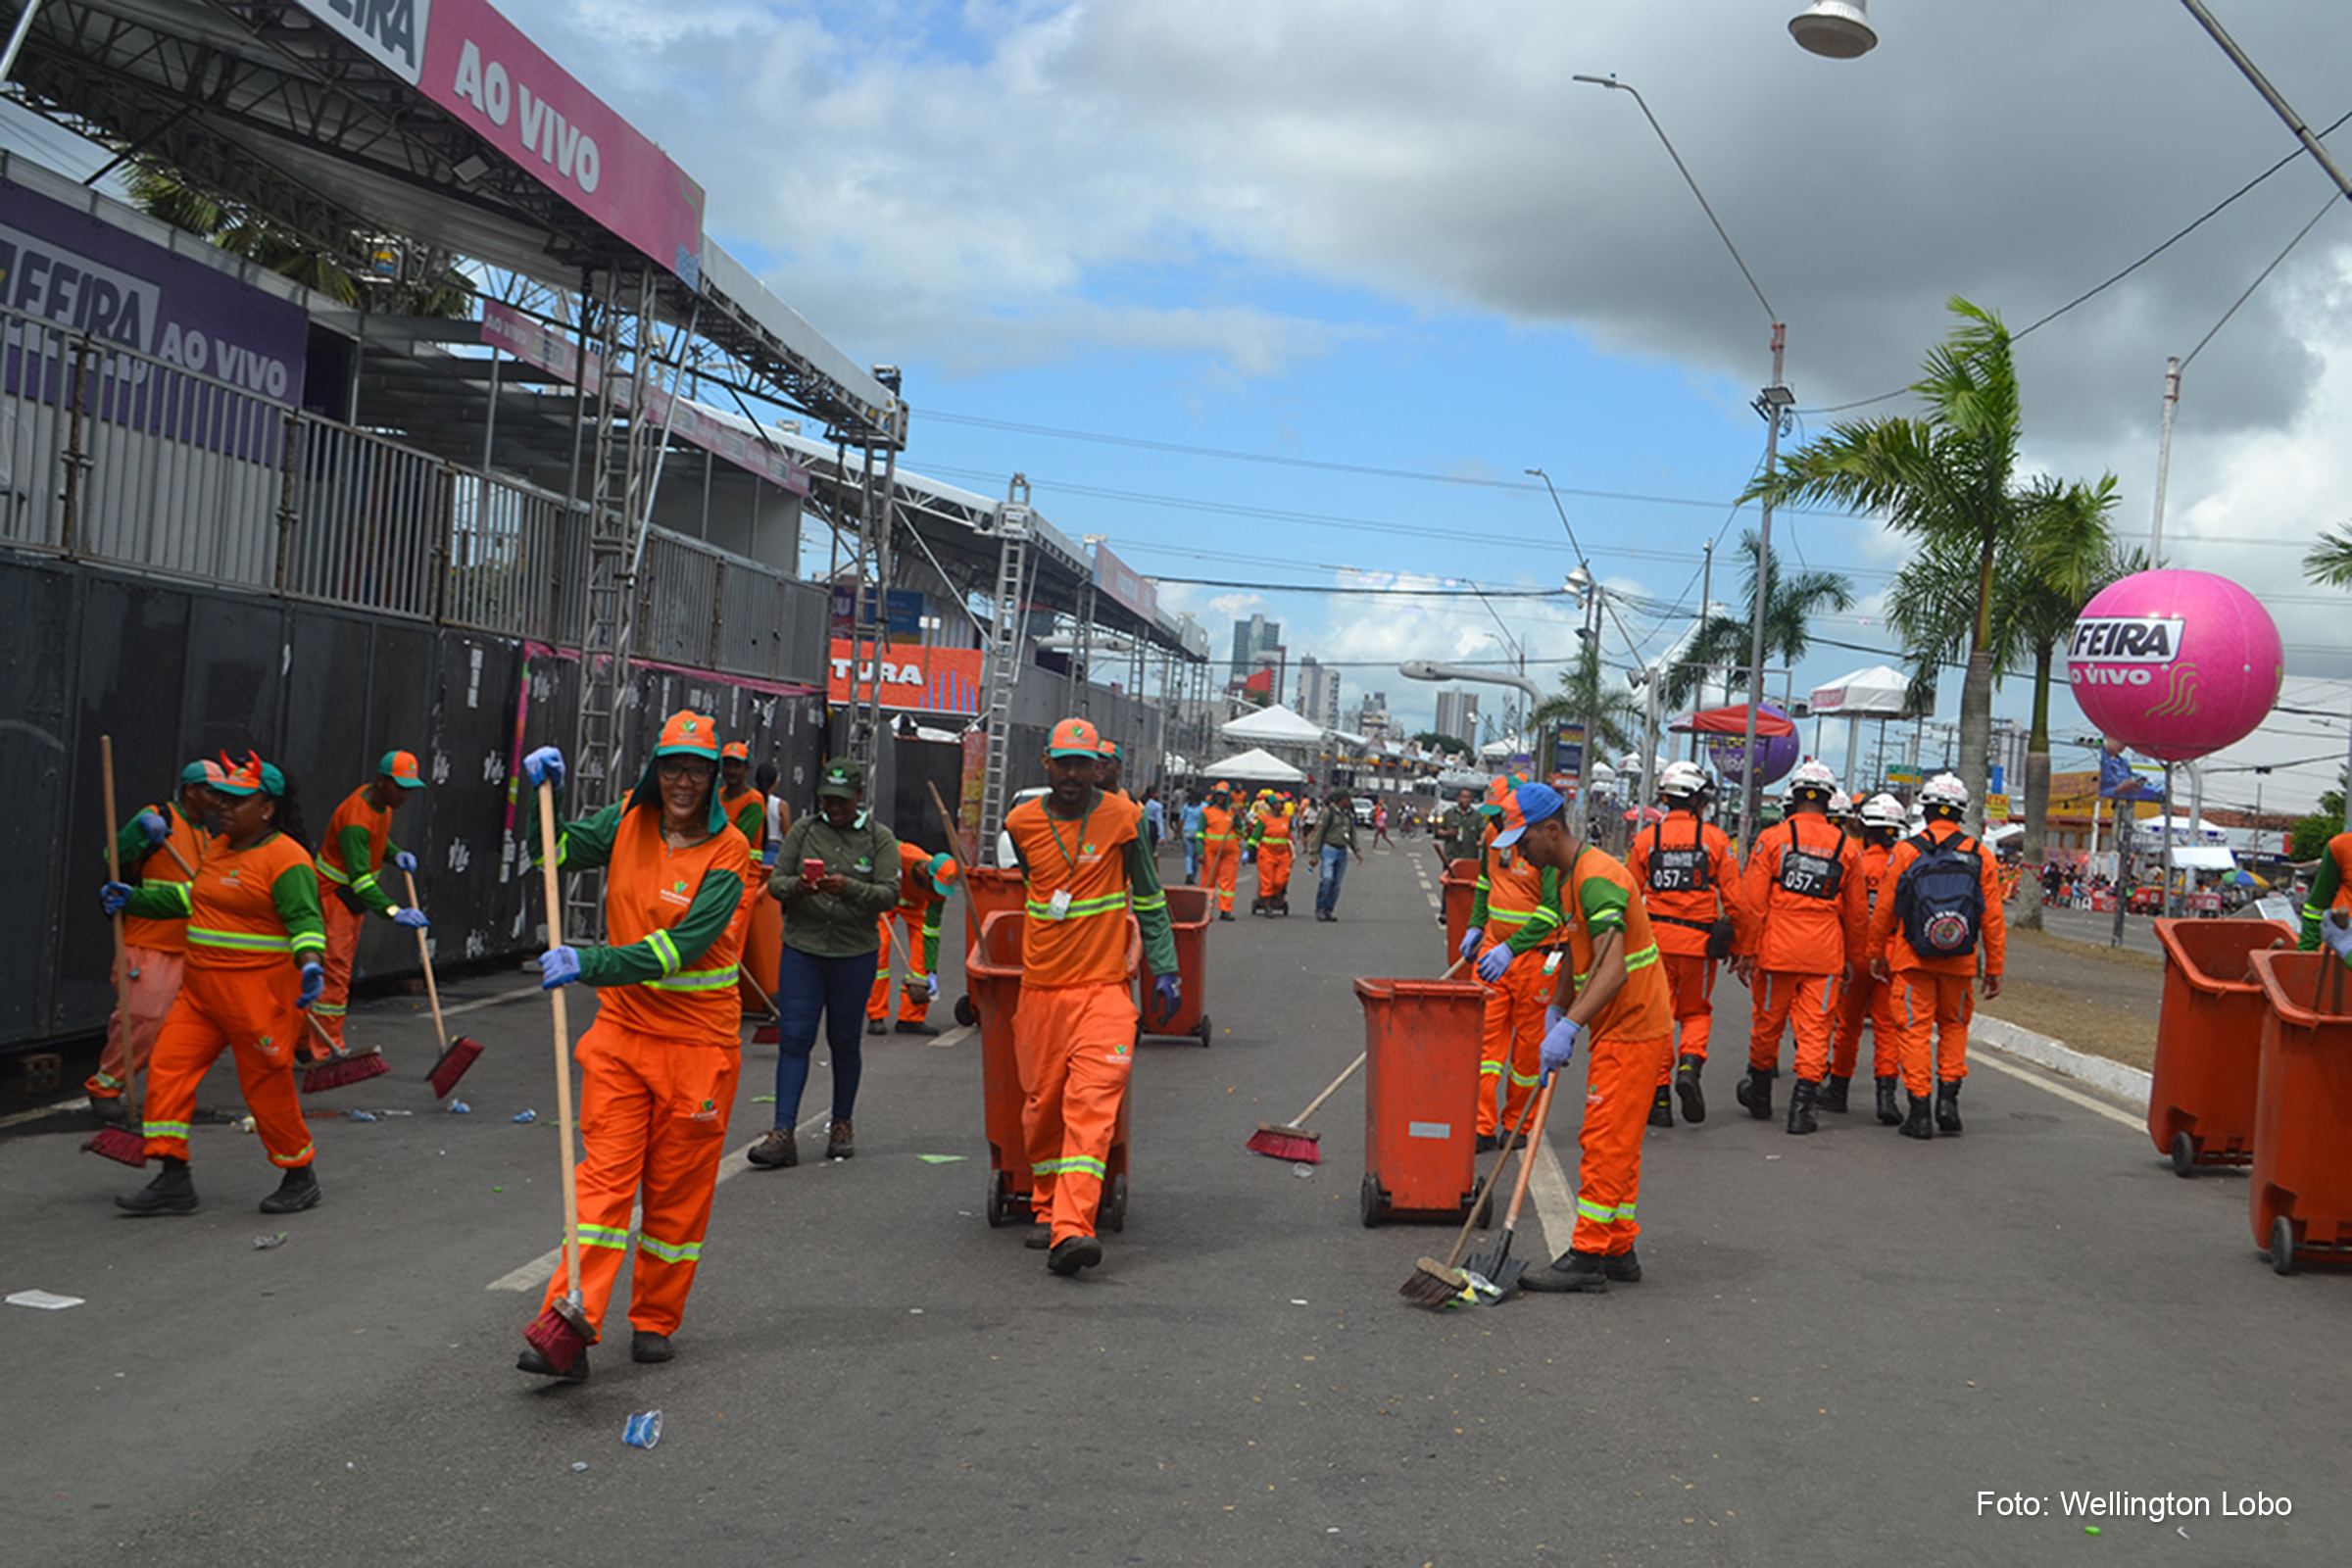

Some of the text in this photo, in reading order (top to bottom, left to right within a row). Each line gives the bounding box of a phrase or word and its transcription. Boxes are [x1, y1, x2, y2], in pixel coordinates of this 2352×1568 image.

[454, 38, 511, 127] AO
[518, 82, 600, 194] VIVO
[160, 321, 208, 372] AO
[215, 339, 287, 398] VIVO
[2084, 668, 2152, 685] VIVO
[1654, 869, 1681, 888] 057
[1786, 869, 1813, 892] 057
